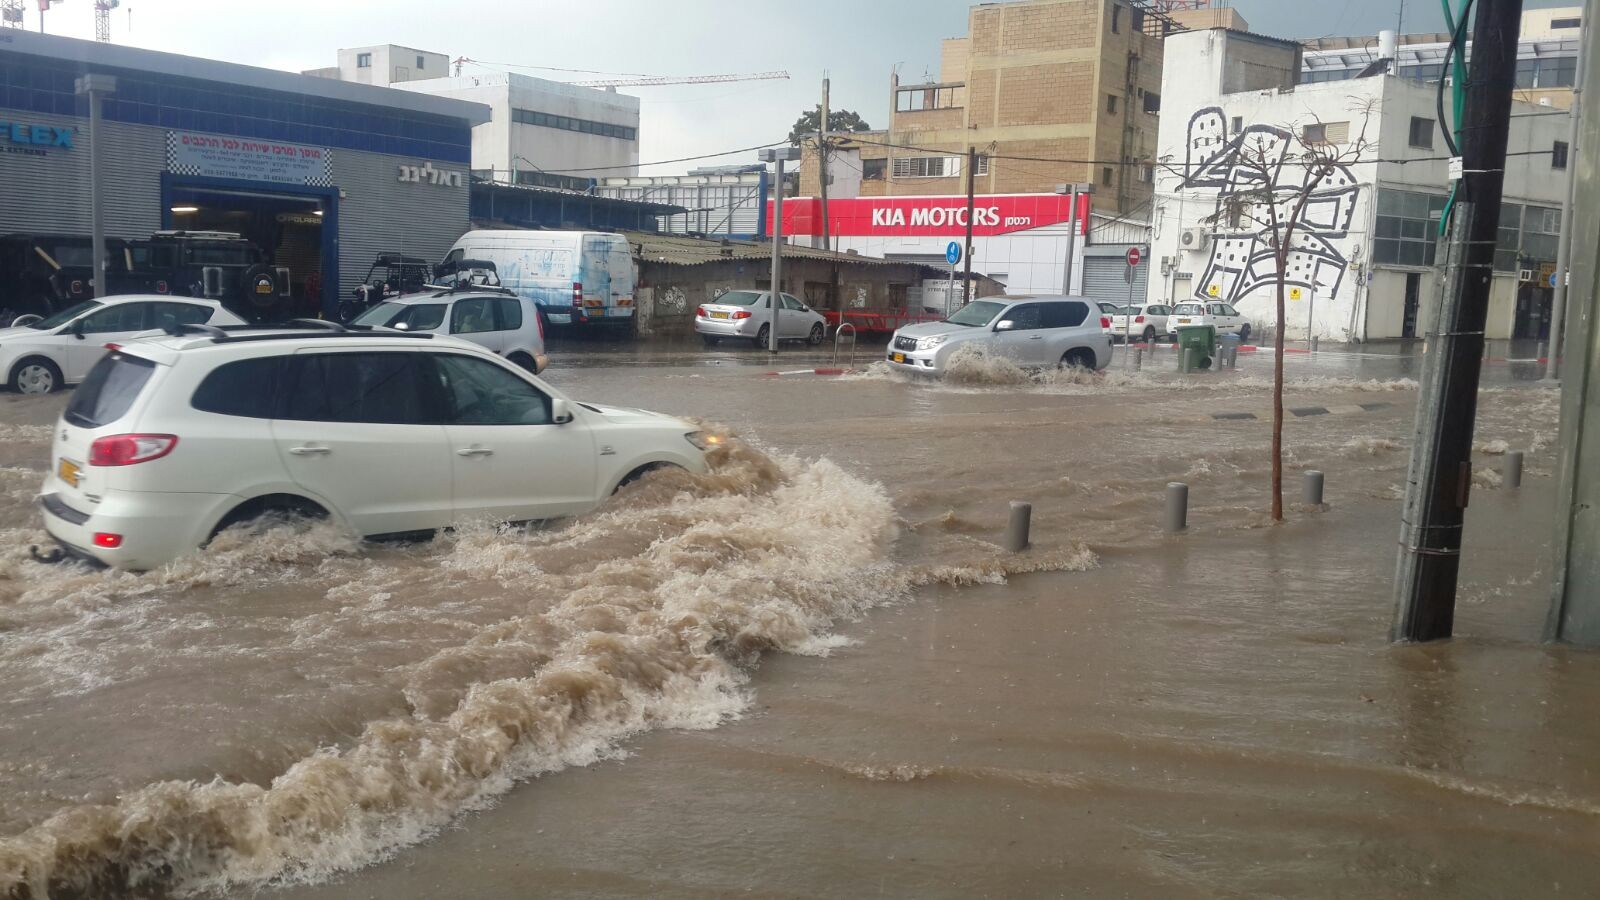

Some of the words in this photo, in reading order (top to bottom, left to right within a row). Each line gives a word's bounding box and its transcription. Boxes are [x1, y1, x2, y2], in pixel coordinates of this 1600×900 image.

[222, 138, 240, 149] לכל
[242, 141, 269, 153] שירות
[872, 207, 905, 226] KIA
[910, 206, 1000, 227] MOTORS
[1004, 216, 1031, 228] רכטמן
